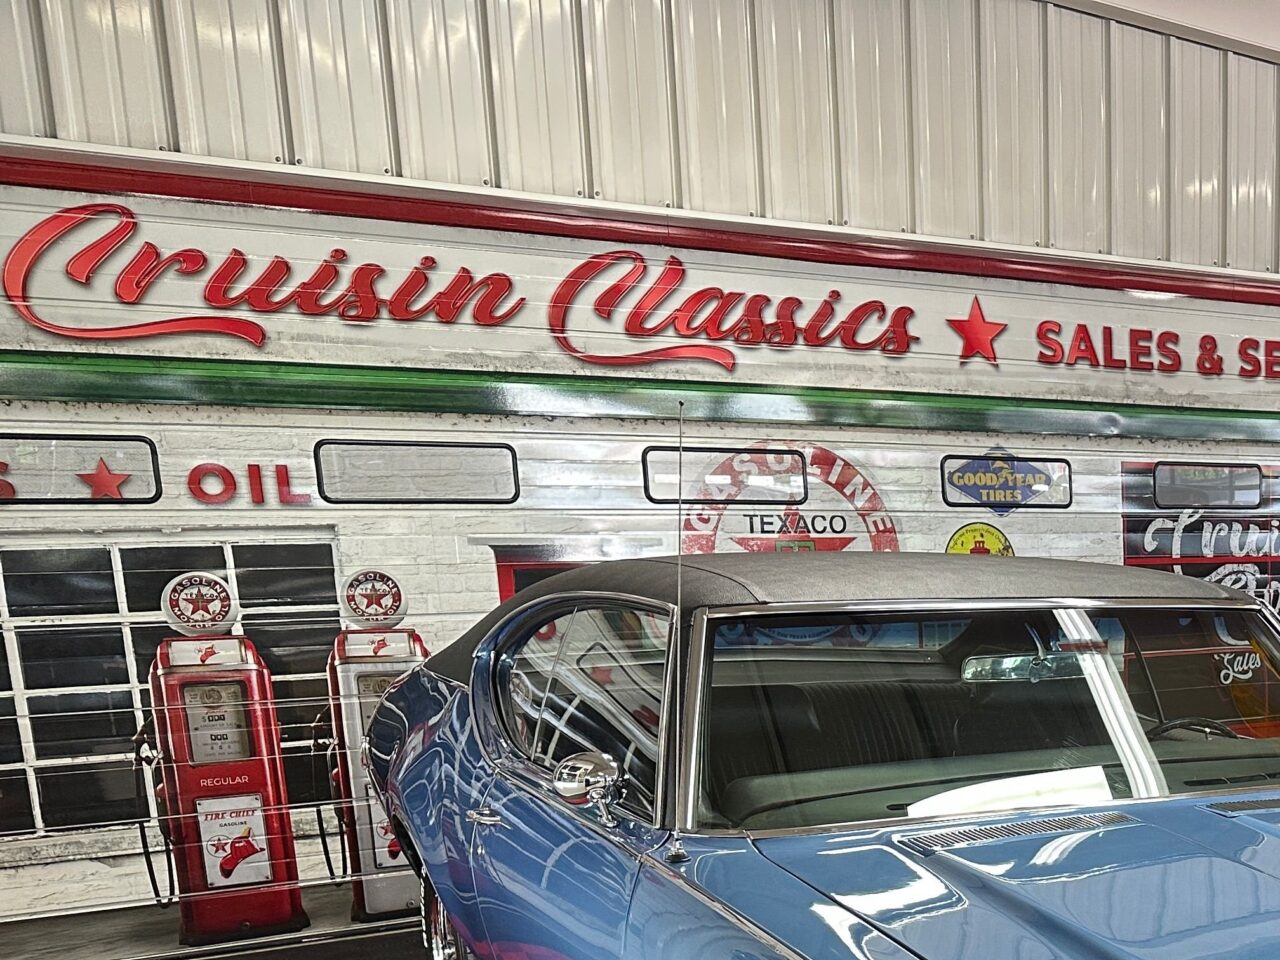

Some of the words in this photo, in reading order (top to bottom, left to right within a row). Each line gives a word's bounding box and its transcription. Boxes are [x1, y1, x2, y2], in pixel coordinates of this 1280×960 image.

[3, 202, 527, 348] Cruisin
[548, 250, 921, 372] Classics
[1036, 319, 1182, 373] SALES
[1197, 334, 1225, 377] &
[187, 462, 313, 505] OIL
[980, 489, 1022, 502] TIRES
[743, 513, 848, 535] TEXACO
[171, 577, 227, 599] GASOLINE
[348, 573, 398, 594] GASOLINE
[200, 775, 249, 787] REGULAR
[219, 820, 248, 828] GASOLINE
